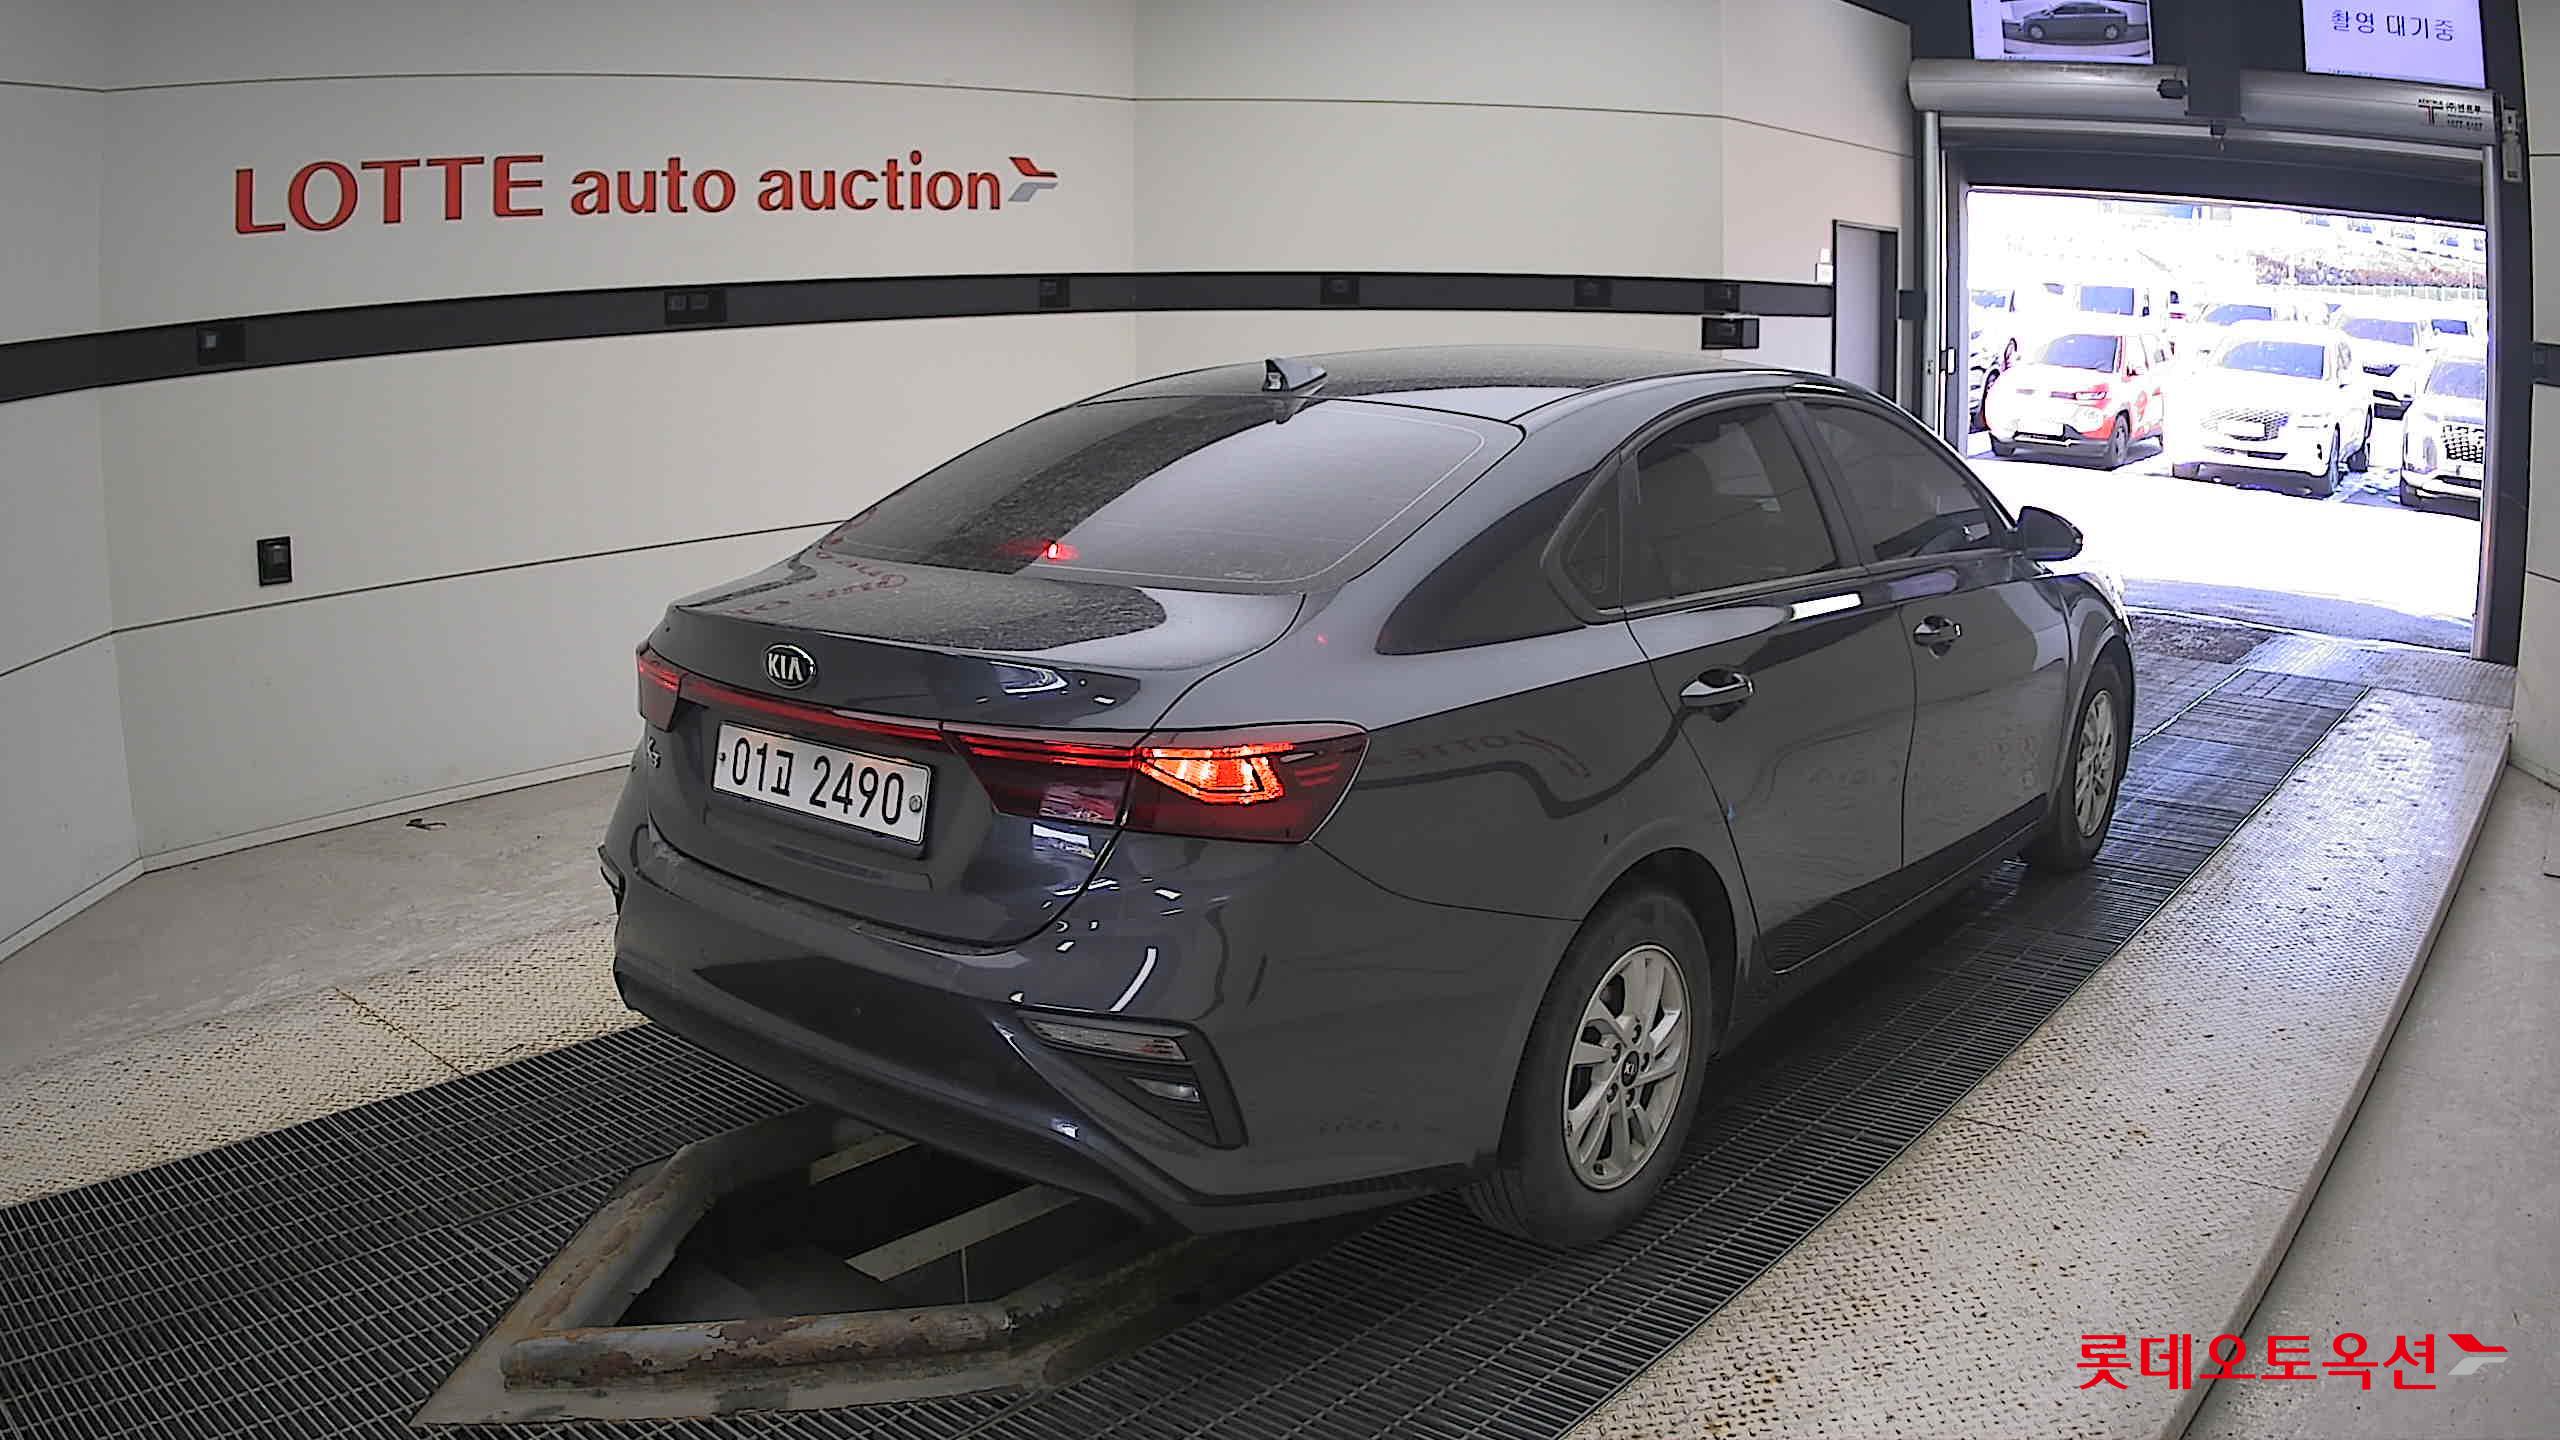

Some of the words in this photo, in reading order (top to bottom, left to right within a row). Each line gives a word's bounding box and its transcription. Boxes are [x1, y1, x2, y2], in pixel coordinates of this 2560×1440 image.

[2330, 9, 2376, 35] 촬영
[2386, 15, 2456, 42] 대기중
[235, 154, 545, 234] LOTTE
[570, 157, 736, 215] auto
[757, 150, 1002, 212] auction
[768, 653, 804, 681] KIA
[732, 737, 793, 797] 01고
[809, 755, 904, 825] 2490
